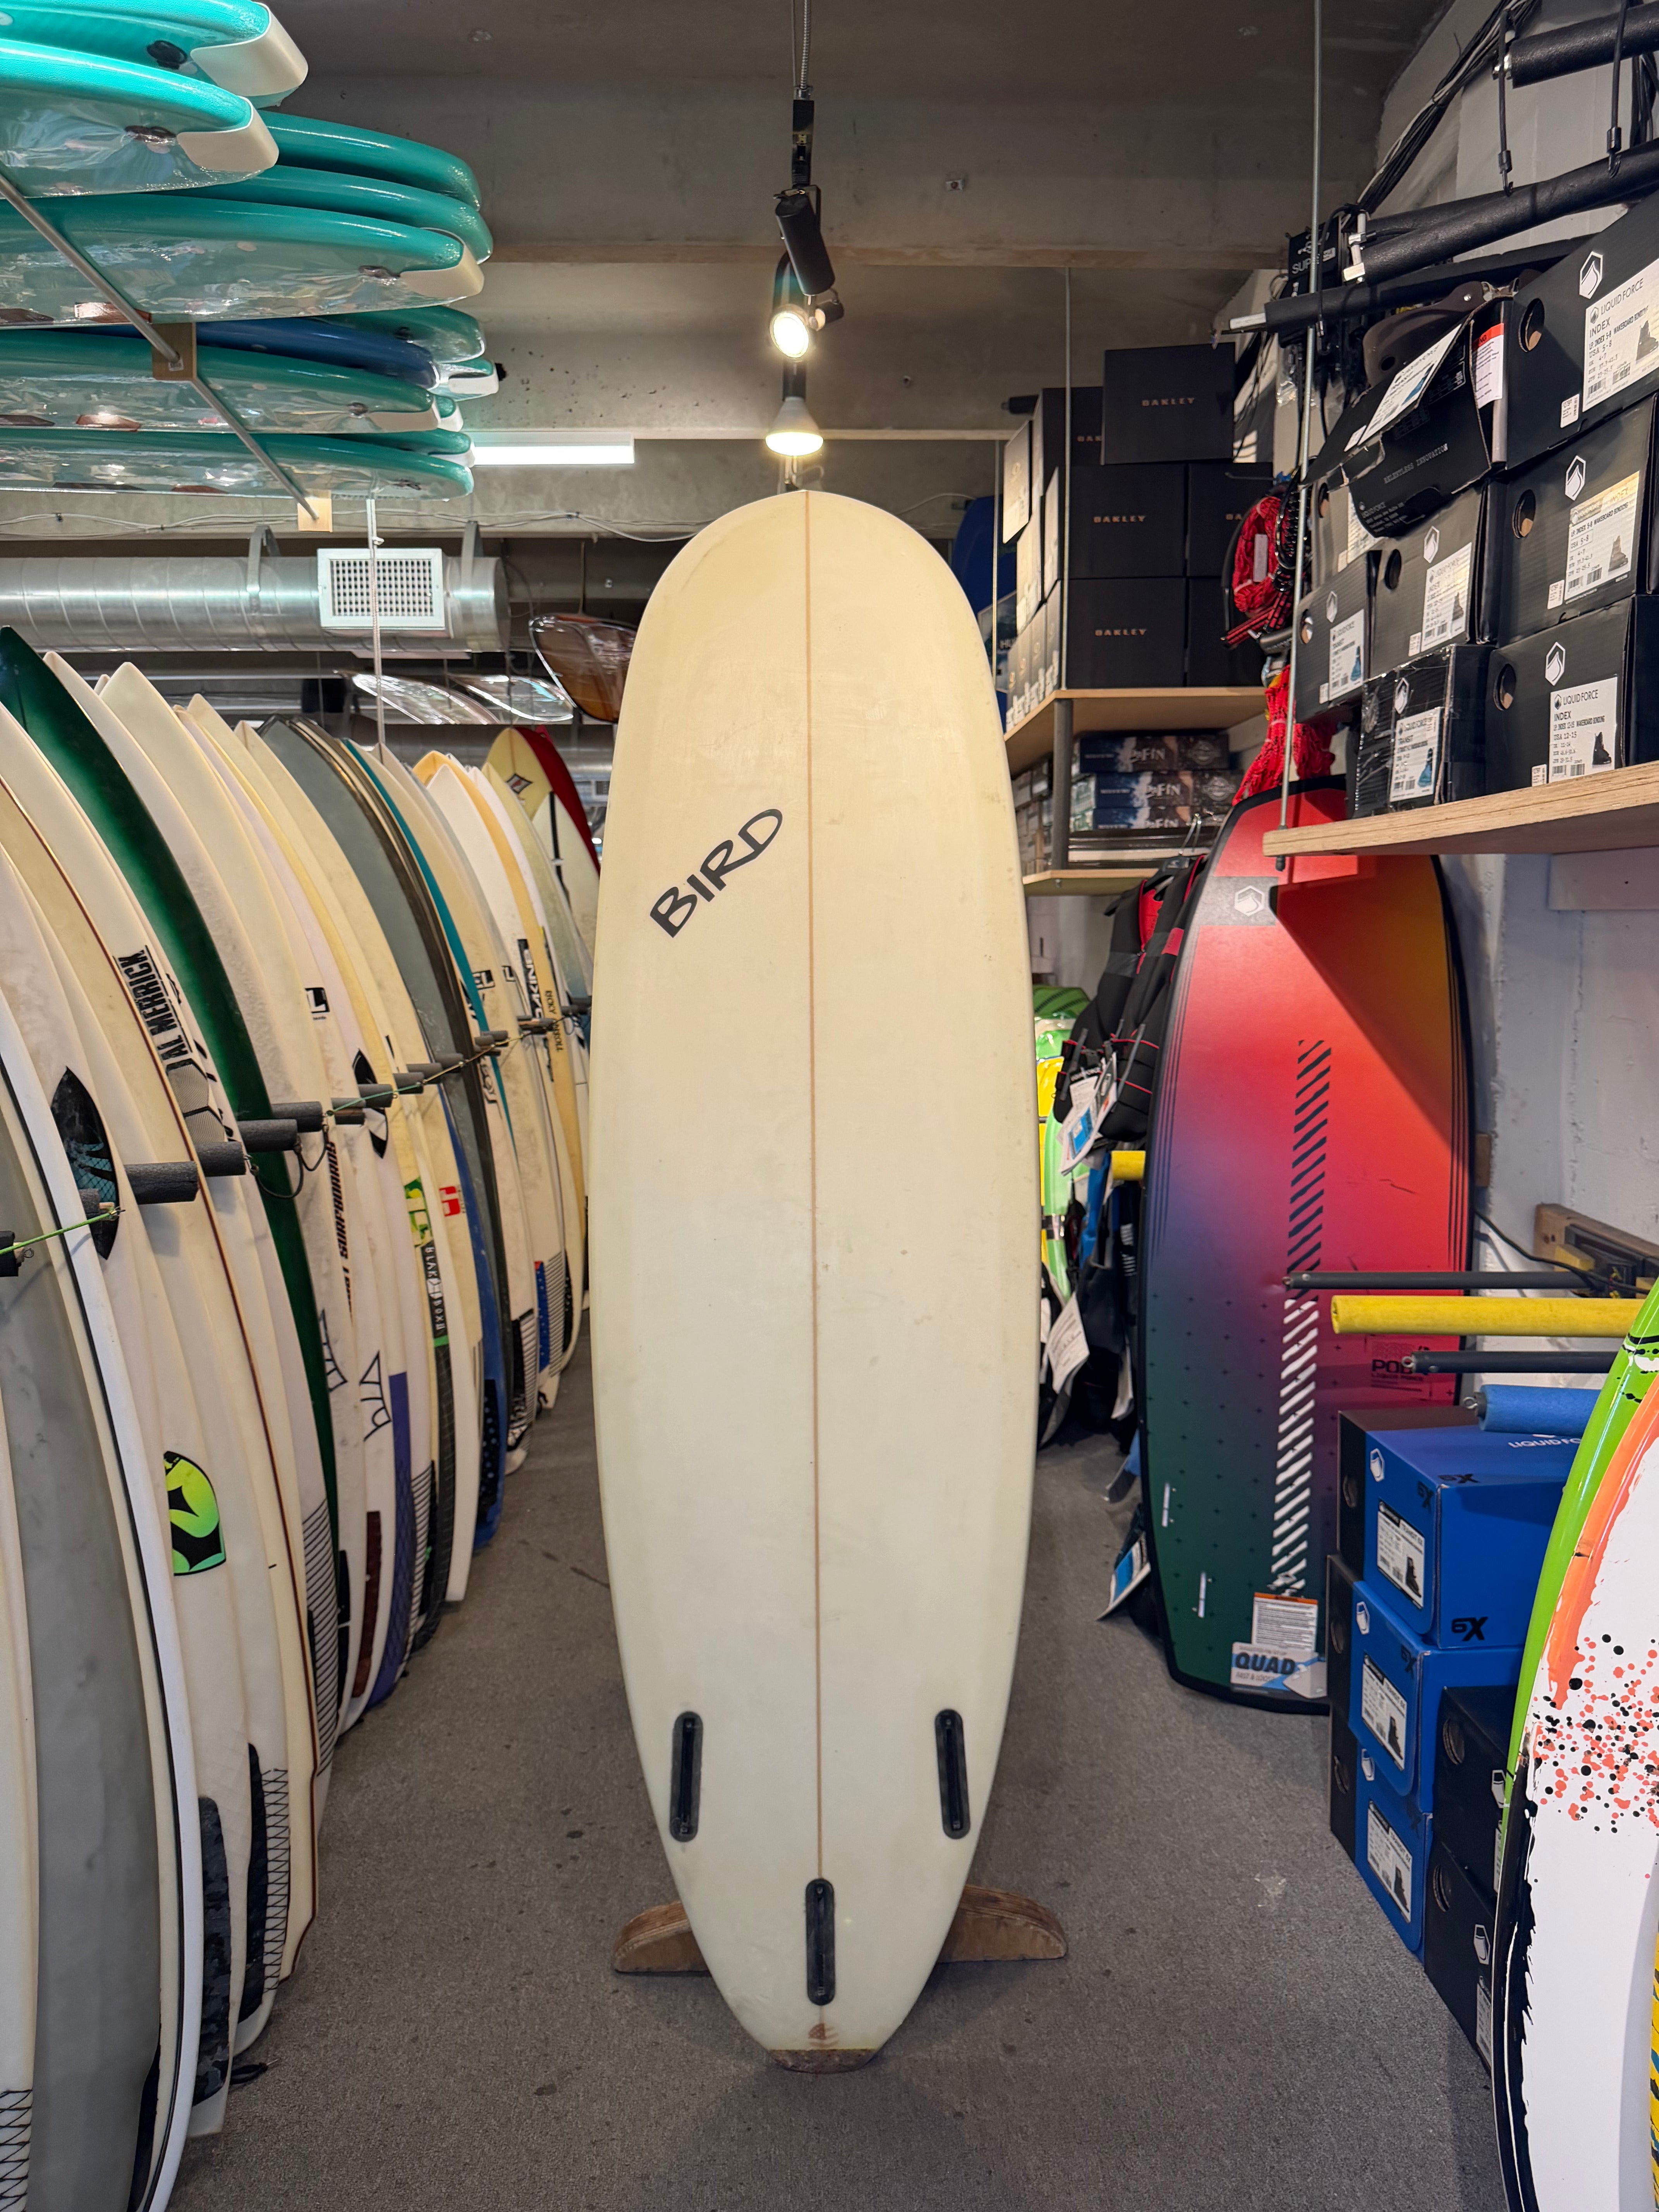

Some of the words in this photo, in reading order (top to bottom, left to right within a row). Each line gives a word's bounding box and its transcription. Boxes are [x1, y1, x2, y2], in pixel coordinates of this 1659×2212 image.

[1590, 317, 1610, 338] INDEX
[1142, 397, 1195, 406] OAKLEY
[1563, 694, 1580, 705] LIQUID
[1581, 689, 1598, 701] FORCE
[1554, 711, 1571, 722] INDEX
[650, 809, 783, 938] BIRD
[118, 950, 178, 1036] MERRICK
[544, 991, 557, 1015] RICKY
[156, 1035, 189, 1060] AL
[1508, 1438, 1561, 1448] LIQUID
[1451, 1616, 1488, 1642] 6X
[1236, 1652, 1296, 1675] QUAD
